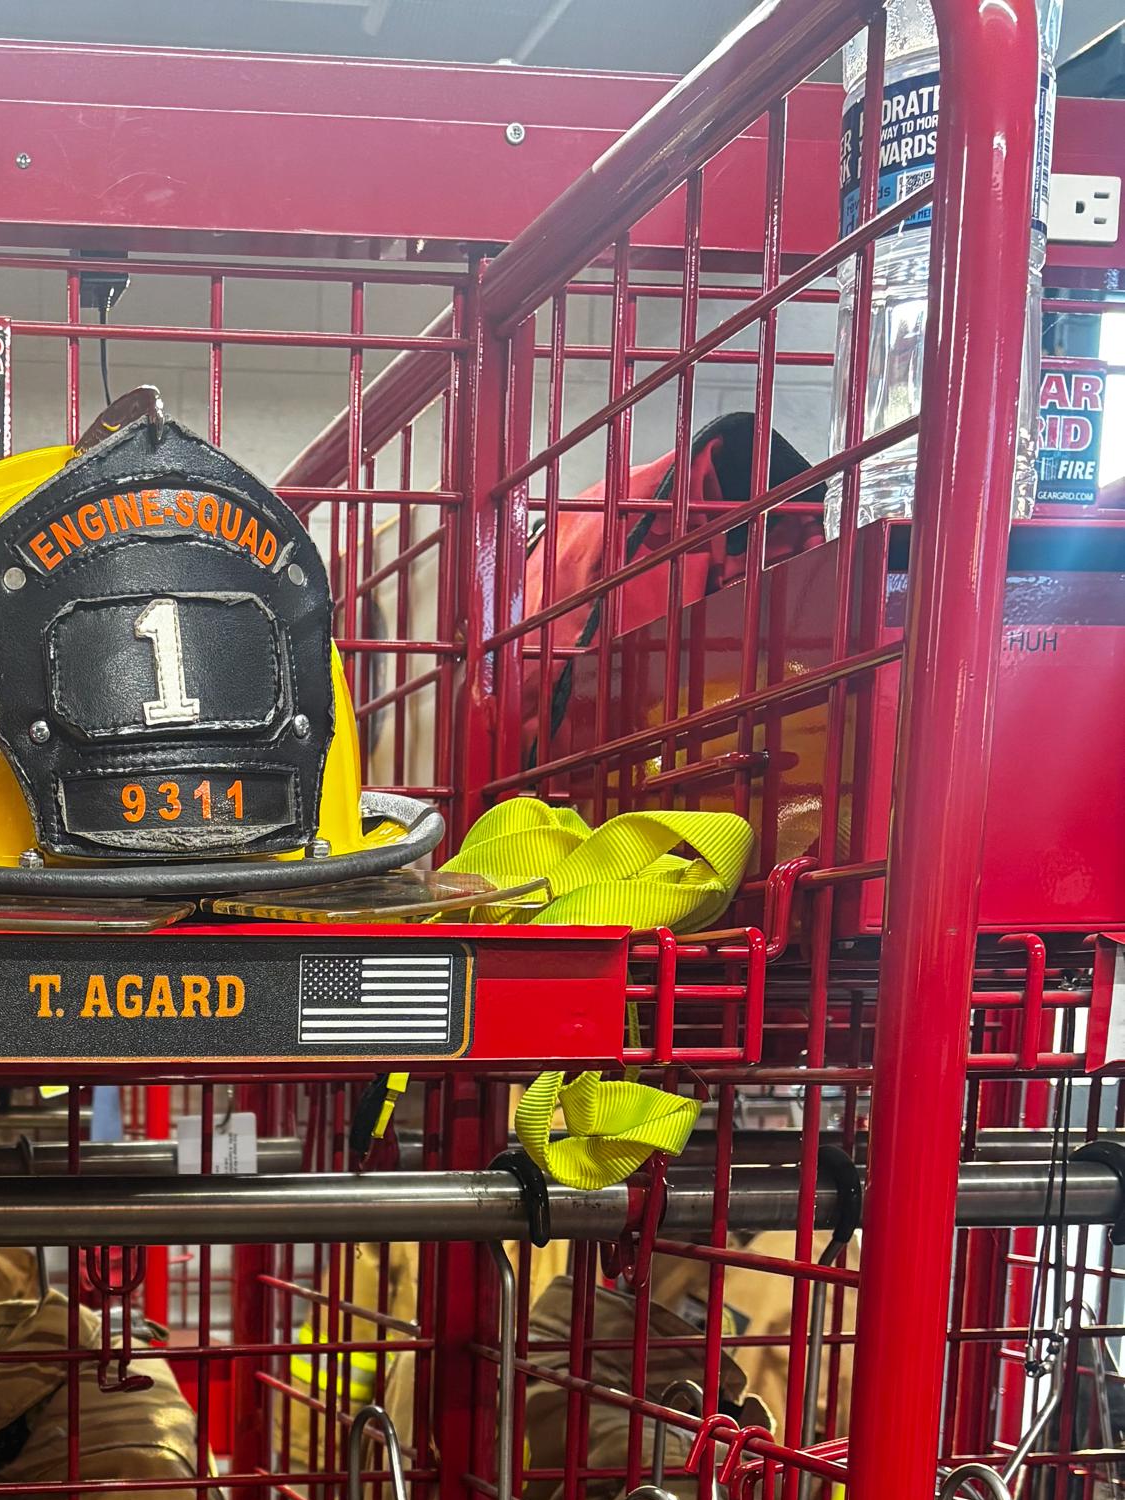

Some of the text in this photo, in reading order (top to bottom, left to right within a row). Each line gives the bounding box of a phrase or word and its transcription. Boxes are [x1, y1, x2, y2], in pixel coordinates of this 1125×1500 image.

[901, 119, 914, 135] TO
[916, 114, 939, 131] MOR
[1039, 373, 1104, 412] AR
[1037, 414, 1093, 452] RID
[1057, 460, 1096, 480] FIRE
[28, 488, 278, 572] ENGINE-SQUAD
[134, 598, 201, 726] 1
[121, 779, 244, 823] 9311
[29, 974, 246, 1018] T. AGARD
